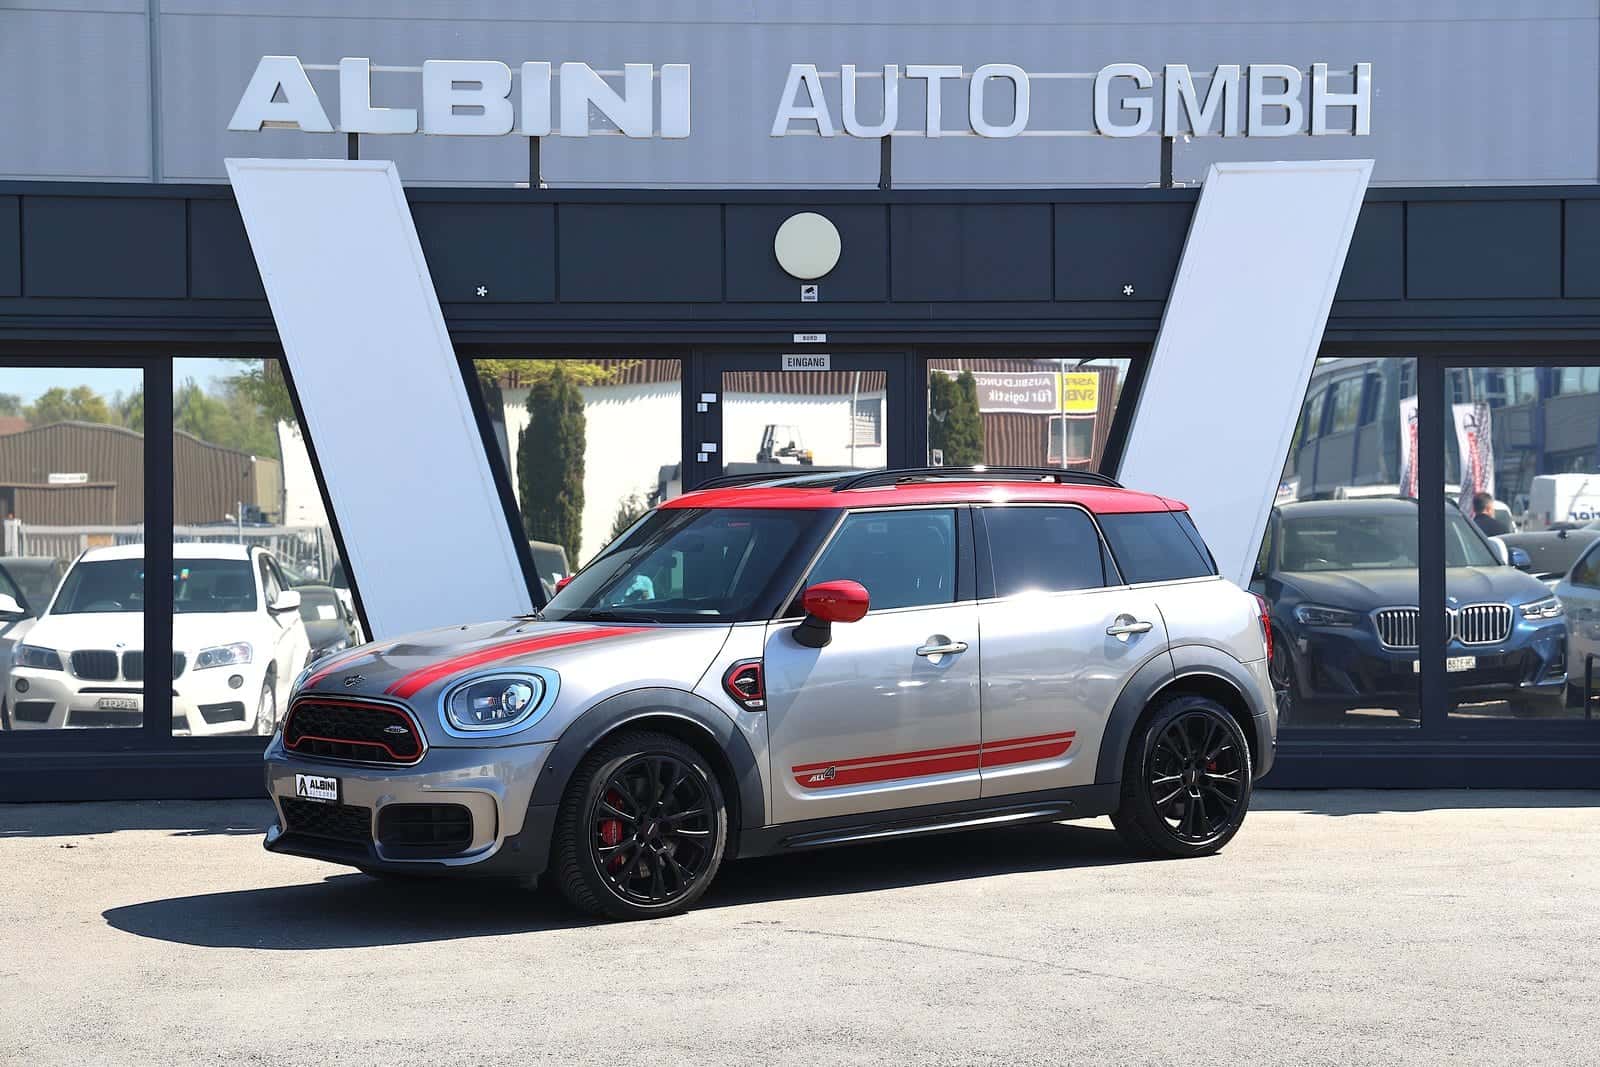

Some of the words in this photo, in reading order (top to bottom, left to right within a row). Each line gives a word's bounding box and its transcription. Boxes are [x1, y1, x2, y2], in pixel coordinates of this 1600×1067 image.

[226, 55, 691, 138] ALBINI
[769, 63, 1030, 138] AUTO
[1094, 62, 1373, 138] GMBH
[787, 357, 825, 368] EINGANG
[310, 779, 336, 792] ALBINI
